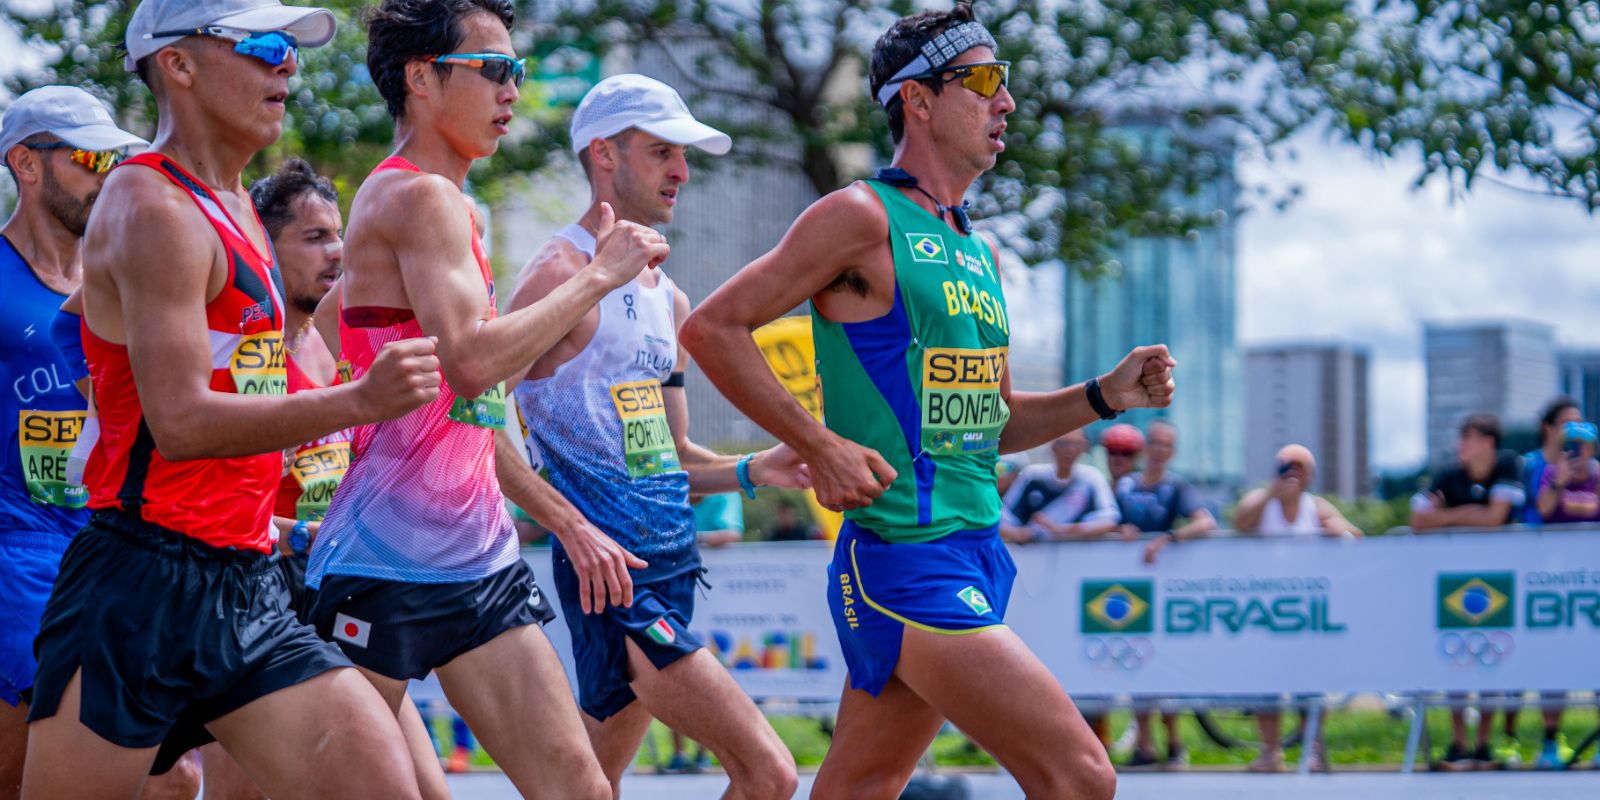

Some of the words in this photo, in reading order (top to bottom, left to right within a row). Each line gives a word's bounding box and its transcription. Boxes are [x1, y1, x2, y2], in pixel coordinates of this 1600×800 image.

[635, 350, 672, 372] ITALIA
[14, 363, 71, 403] COL
[28, 449, 68, 482] ARÉ
[839, 573, 860, 631] BRASIL
[1164, 595, 1347, 633] BRASIL
